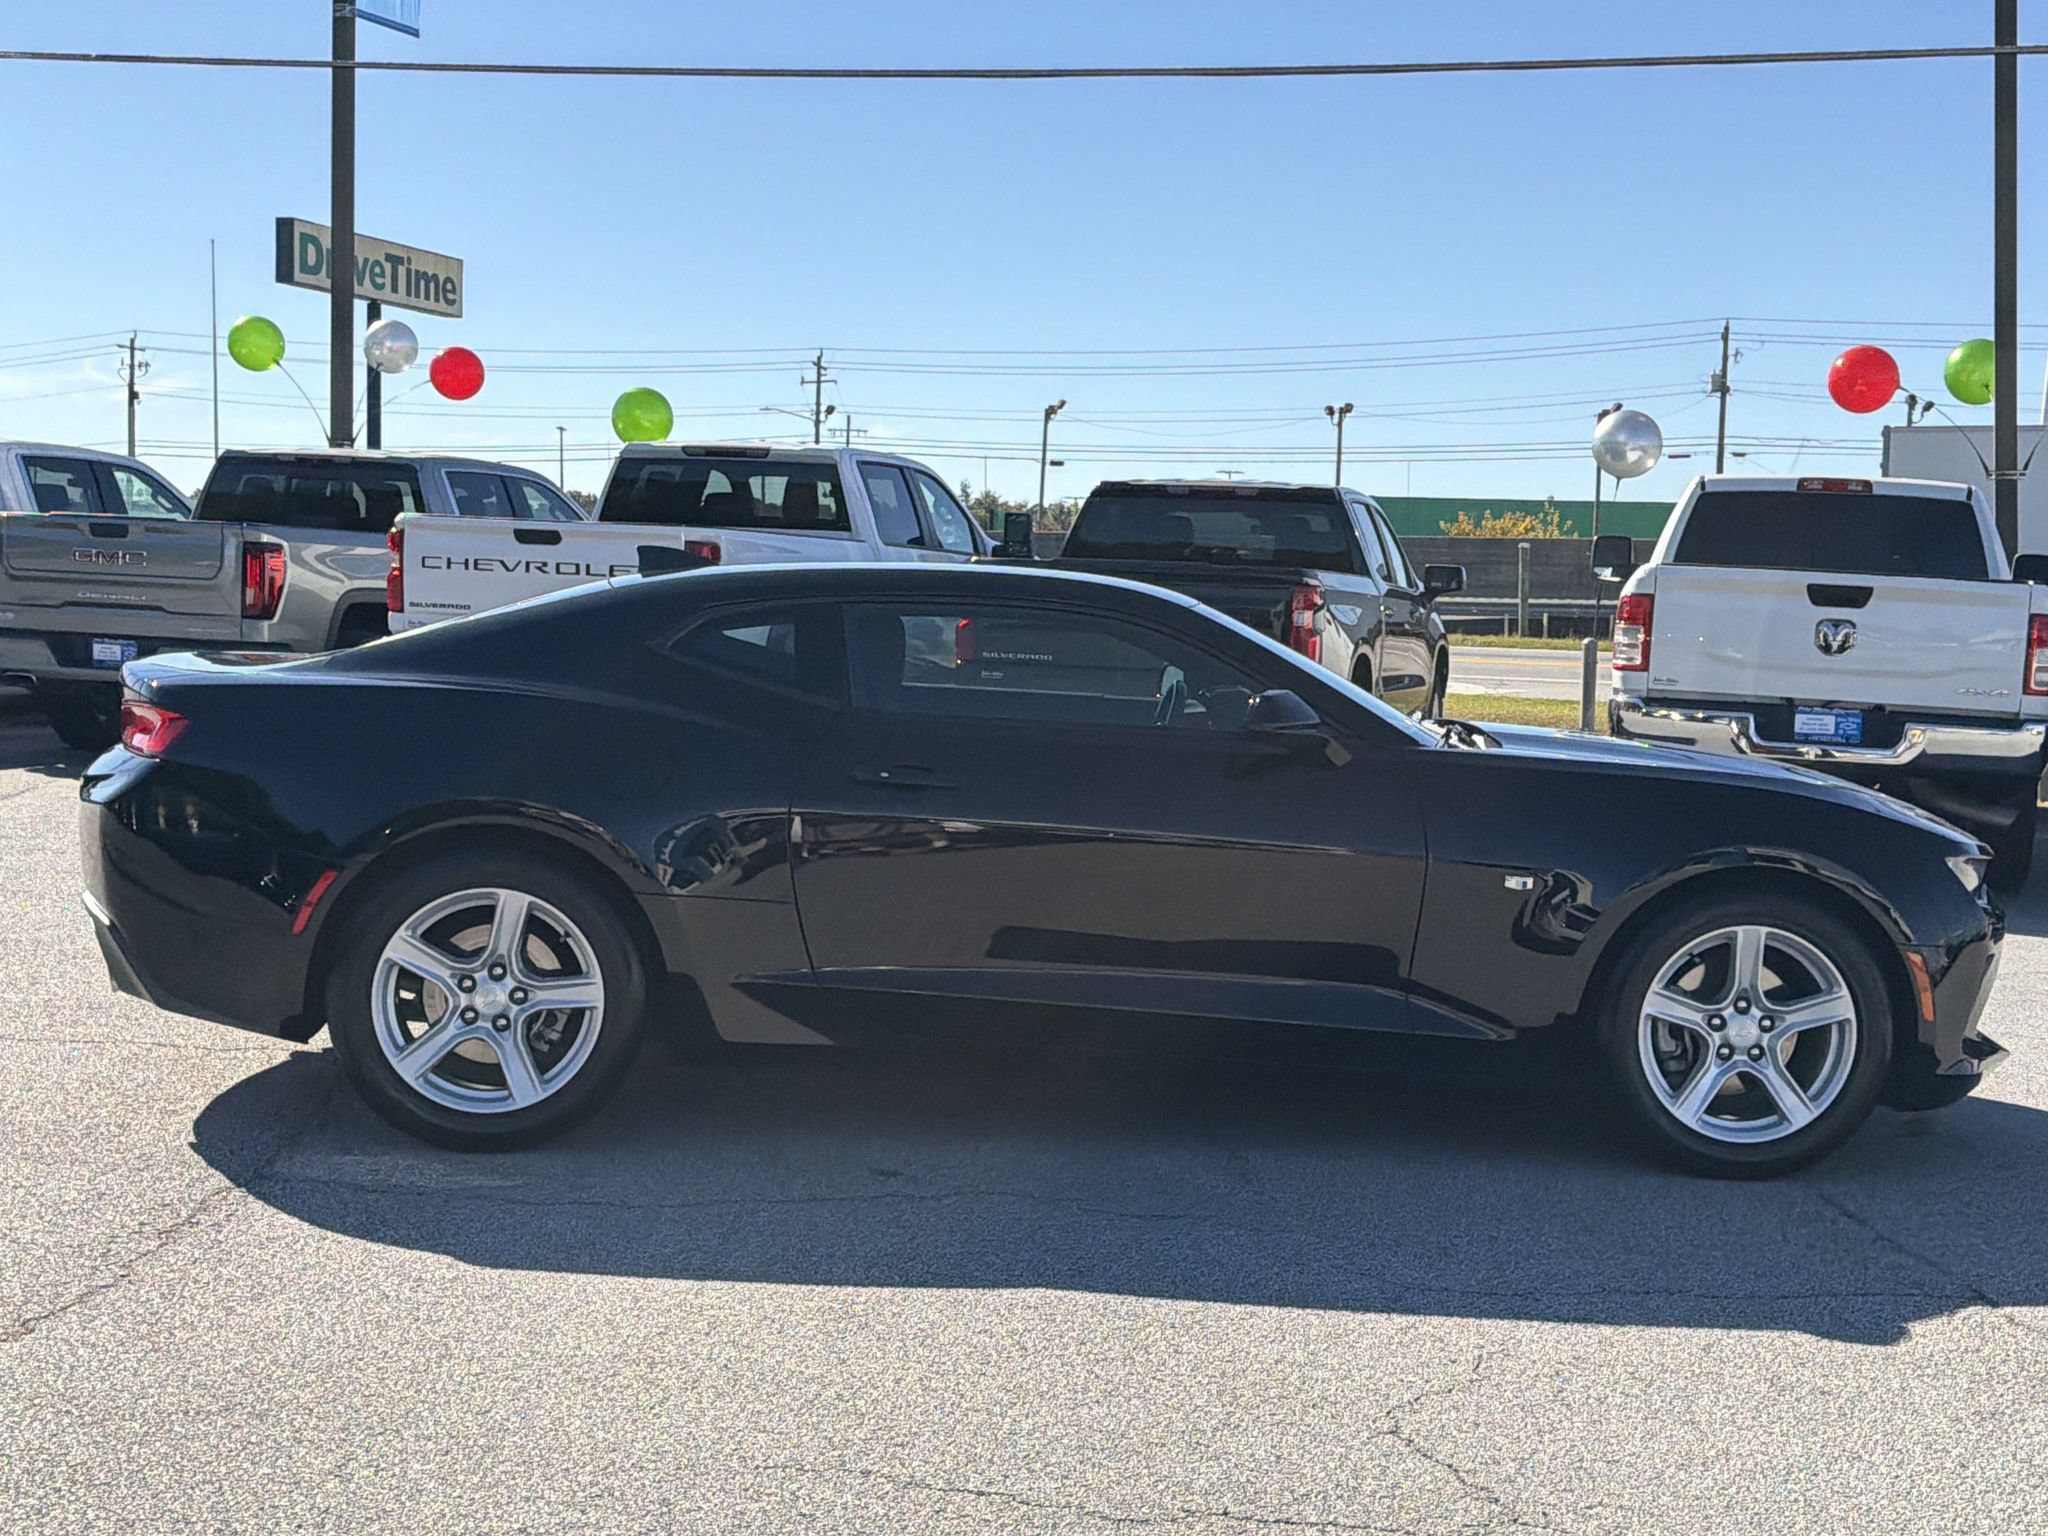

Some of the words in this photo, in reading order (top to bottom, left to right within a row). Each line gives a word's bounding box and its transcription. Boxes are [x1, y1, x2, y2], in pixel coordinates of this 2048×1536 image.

[73, 549, 147, 567] GMC
[421, 556, 638, 578] CHEVROLE
[408, 601, 471, 611] SILVERADO
